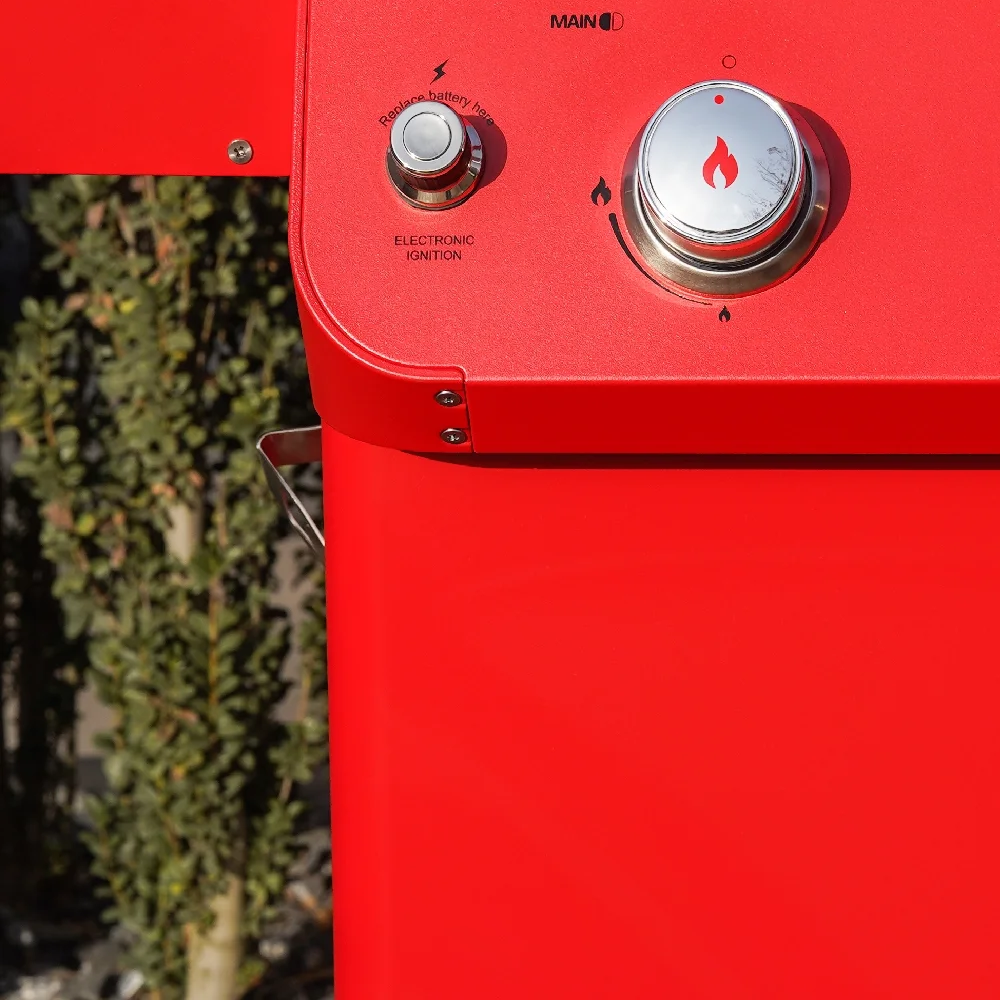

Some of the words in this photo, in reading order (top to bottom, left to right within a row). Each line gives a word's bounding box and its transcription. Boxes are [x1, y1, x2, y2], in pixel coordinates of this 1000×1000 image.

[550, 14, 596, 29] MAIN
[429, 90, 471, 108] battery
[471, 102, 494, 126] here
[394, 234, 475, 246] ELECTRONIC
[406, 250, 462, 261] IGNITION
